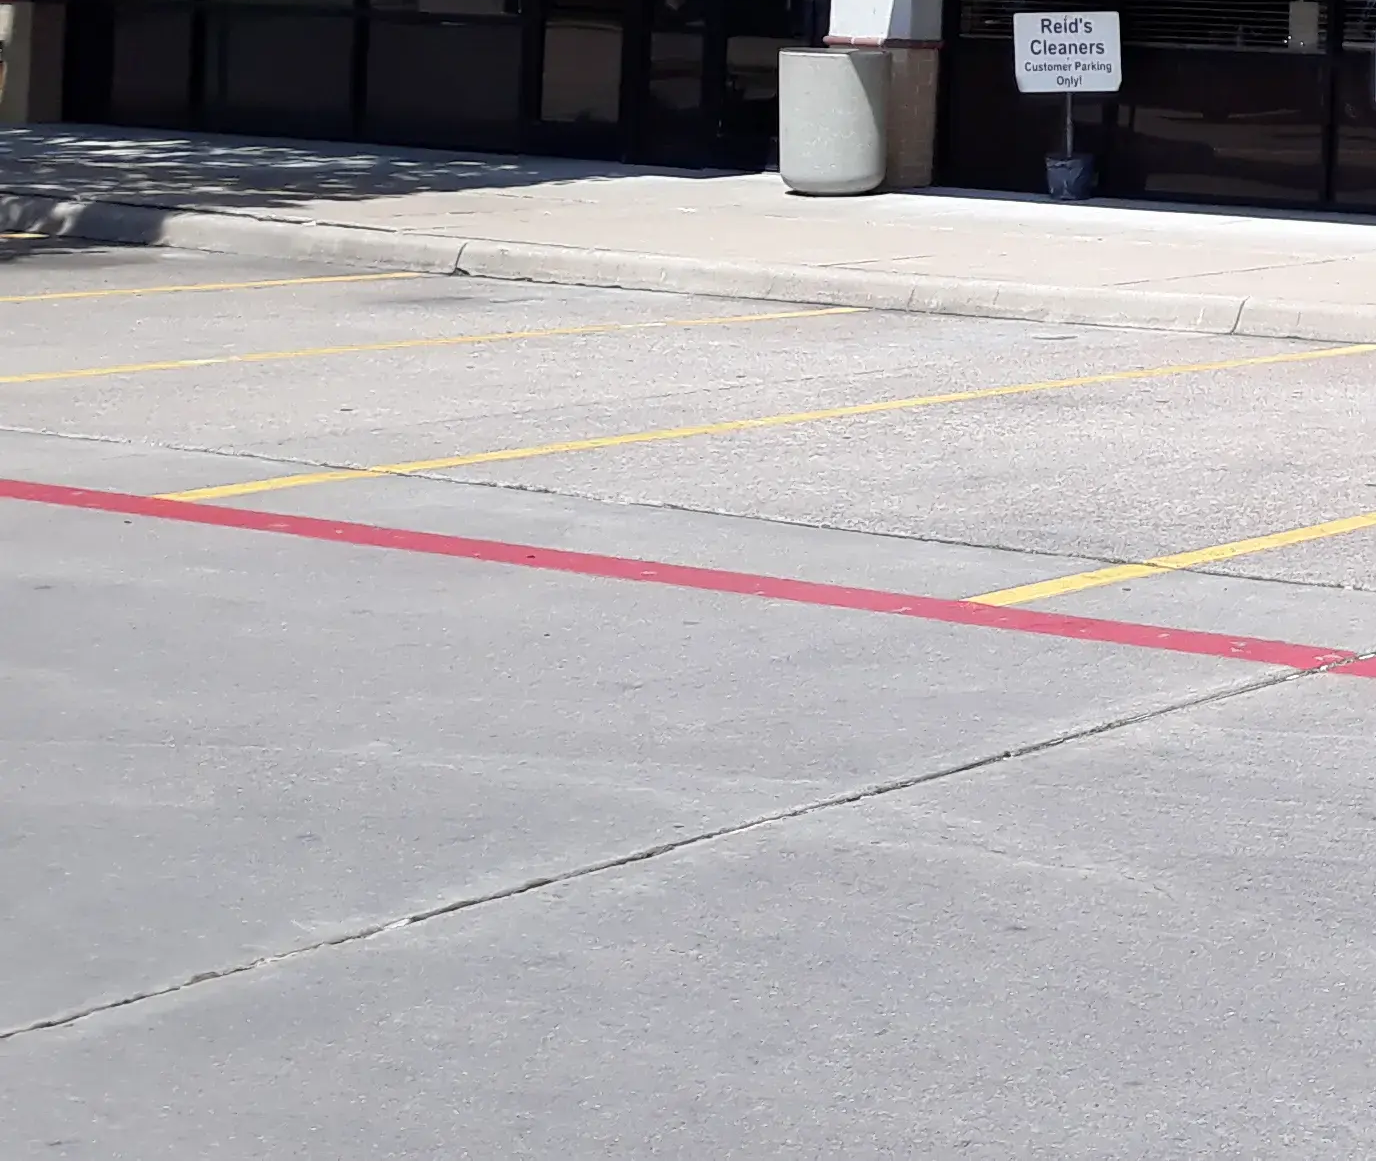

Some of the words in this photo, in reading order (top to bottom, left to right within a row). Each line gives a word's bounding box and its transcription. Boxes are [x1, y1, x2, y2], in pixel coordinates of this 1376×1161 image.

[1041, 17, 1093, 34] Reid's
[1030, 39, 1105, 55] Cleaners
[1024, 62, 1072, 72] Customer
[1074, 61, 1112, 73] Parking
[1056, 75, 1082, 88] Only!
